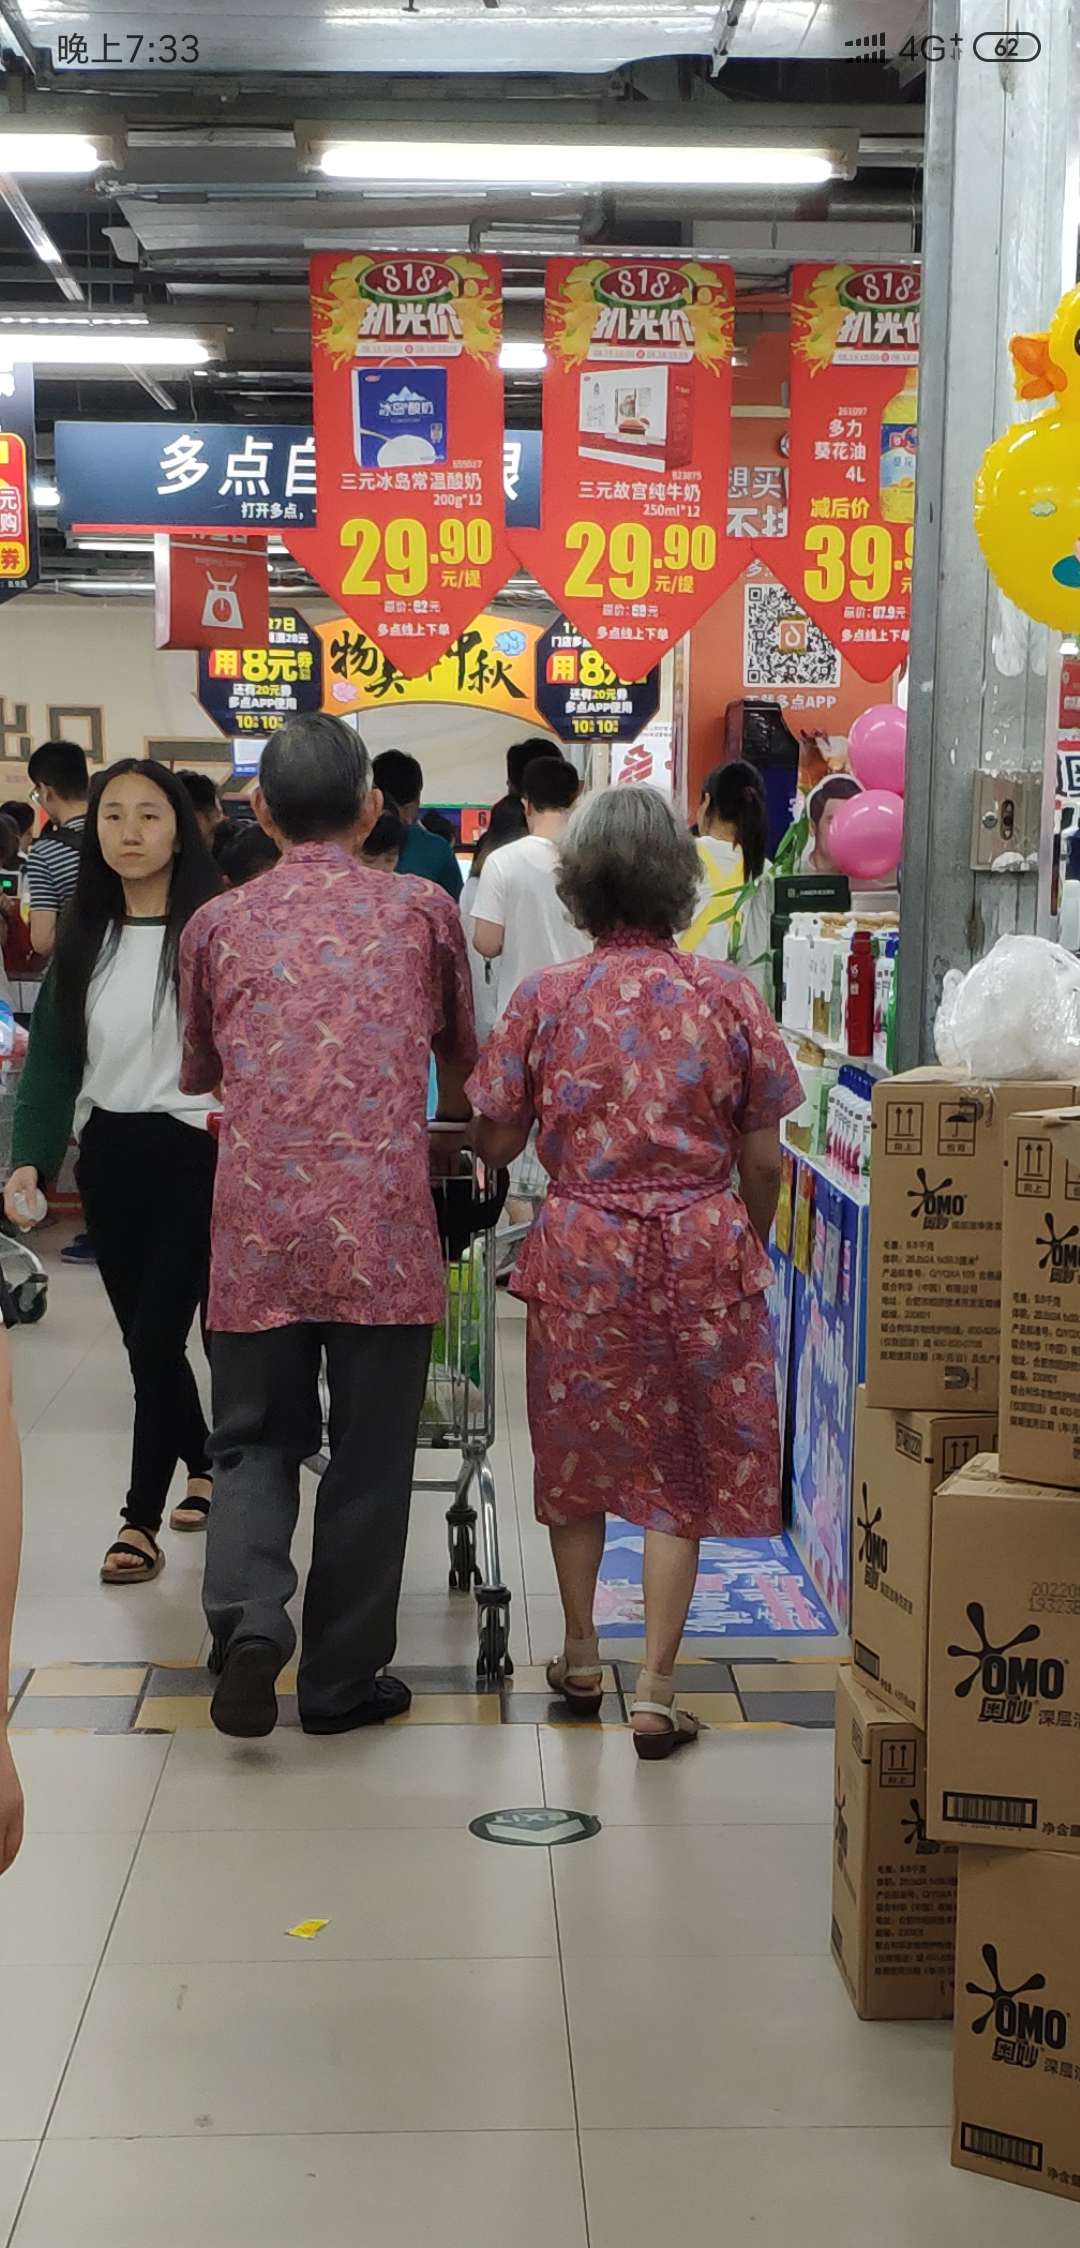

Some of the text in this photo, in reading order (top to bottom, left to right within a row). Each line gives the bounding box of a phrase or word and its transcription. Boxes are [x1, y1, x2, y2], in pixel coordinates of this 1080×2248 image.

[383, 264, 436, 292] 818
[618, 269, 670, 298] 818
[863, 272, 914, 300] 818
[358, 303, 463, 335] 扒光价
[594, 307, 696, 341] 扒光价
[828, 419, 862, 438] 多力
[814, 441, 866, 461] 葵花油
[341, 472, 482, 490] 三元冰岛常温酸奶
[846, 466, 866, 482] 4L
[578, 481, 701, 502] 三元故宫纯牛奶
[810, 497, 869, 519] 减后价
[340, 518, 492, 596] 29.90 元/提
[565, 521, 716, 600] 29.90
[377, 623, 450, 637] 多点线上下单
[597, 626, 669, 641] 多点线上下单
[924, 1194, 965, 1216] OMO
[981, 1654, 1065, 1700] OMO
[977, 1696, 1033, 1724] 奥妙
[994, 1997, 1067, 2051] OMO
[991, 2036, 1039, 2069] 奥妙
